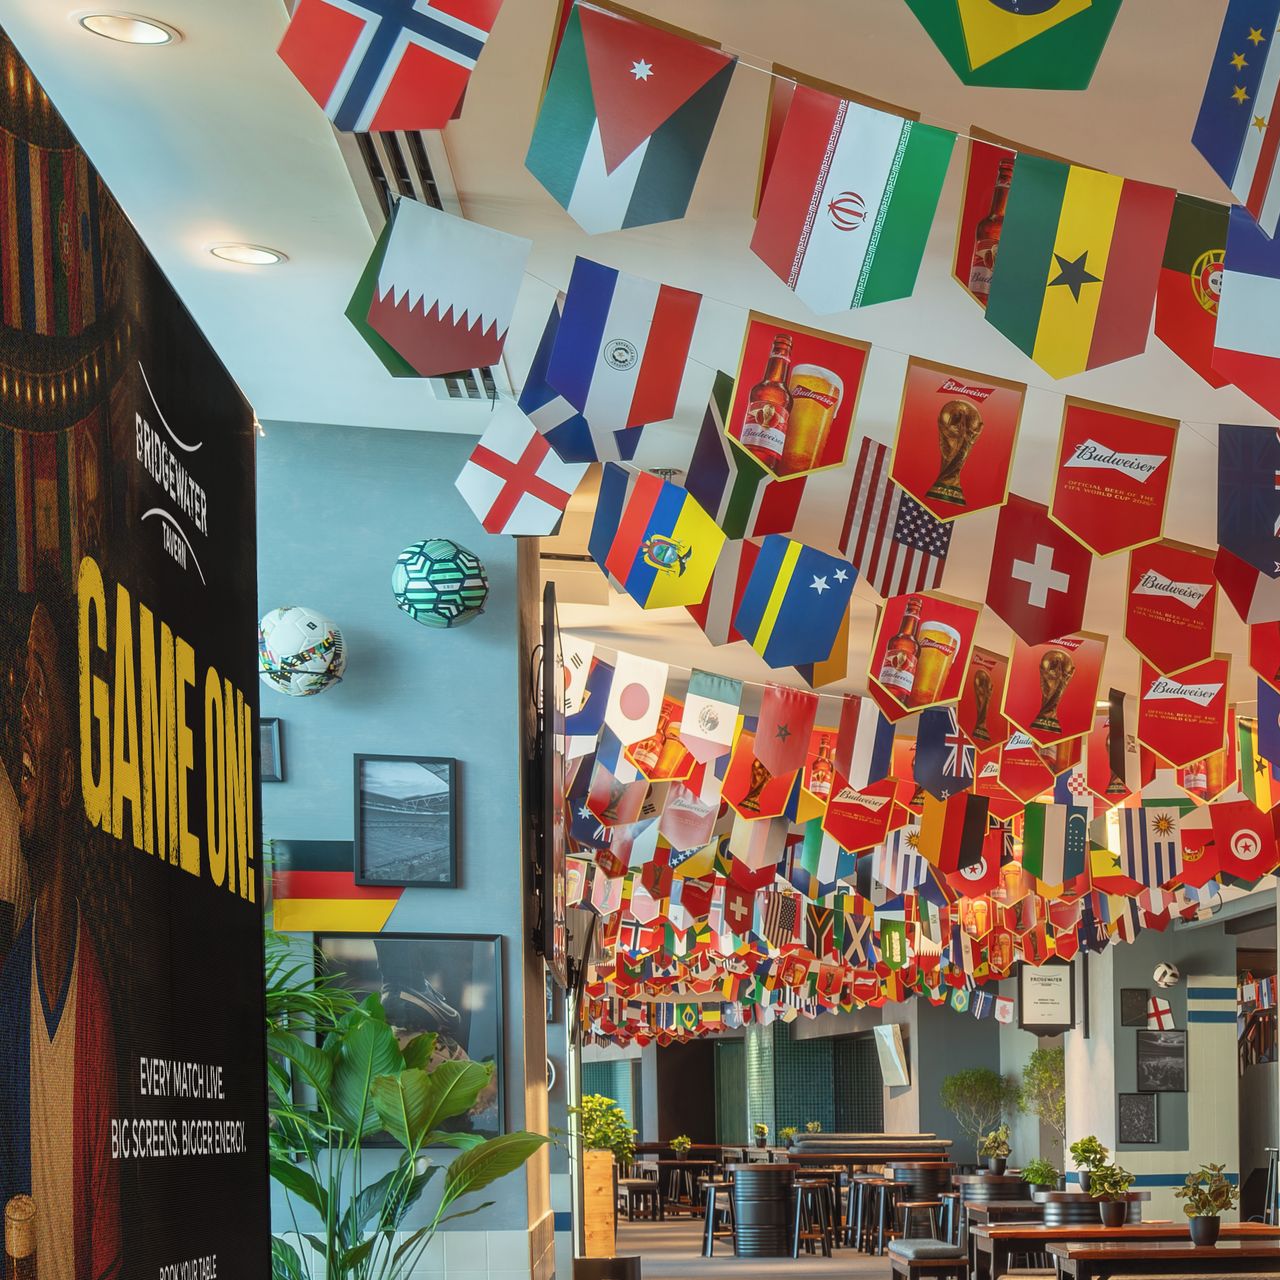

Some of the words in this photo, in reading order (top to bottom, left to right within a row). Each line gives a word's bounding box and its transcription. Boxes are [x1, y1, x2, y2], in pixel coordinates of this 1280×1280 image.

[792, 387, 834, 406] Budweiser
[943, 380, 990, 399] Budweiser
[743, 427, 784, 446] Budweiser
[1075, 443, 1156, 473] Budweiser
[135, 412, 208, 537] BRIDGEWATER
[1068, 480, 1102, 491] OFFICIAL
[1104, 487, 1124, 495] BEER
[1084, 488, 1112, 498] WORLD
[162, 521, 187, 571] TAVERN
[1140, 573, 1205, 600] Budweiser
[1151, 681, 1214, 699] Budweiser
[78, 556, 200, 878] GAME
[205, 666, 255, 903] ON!
[839, 789, 884, 807] Budweiser
[140, 1057, 171, 1096] EVERY
[173, 1060, 204, 1098] MATCH
[206, 1064, 225, 1099] LIVE.
[111, 1118, 130, 1158] BIG
[132, 1118, 180, 1158] SCREENS.
[182, 1119, 214, 1156] BIGGER
[214, 1120, 247, 1154] ENERGY.
